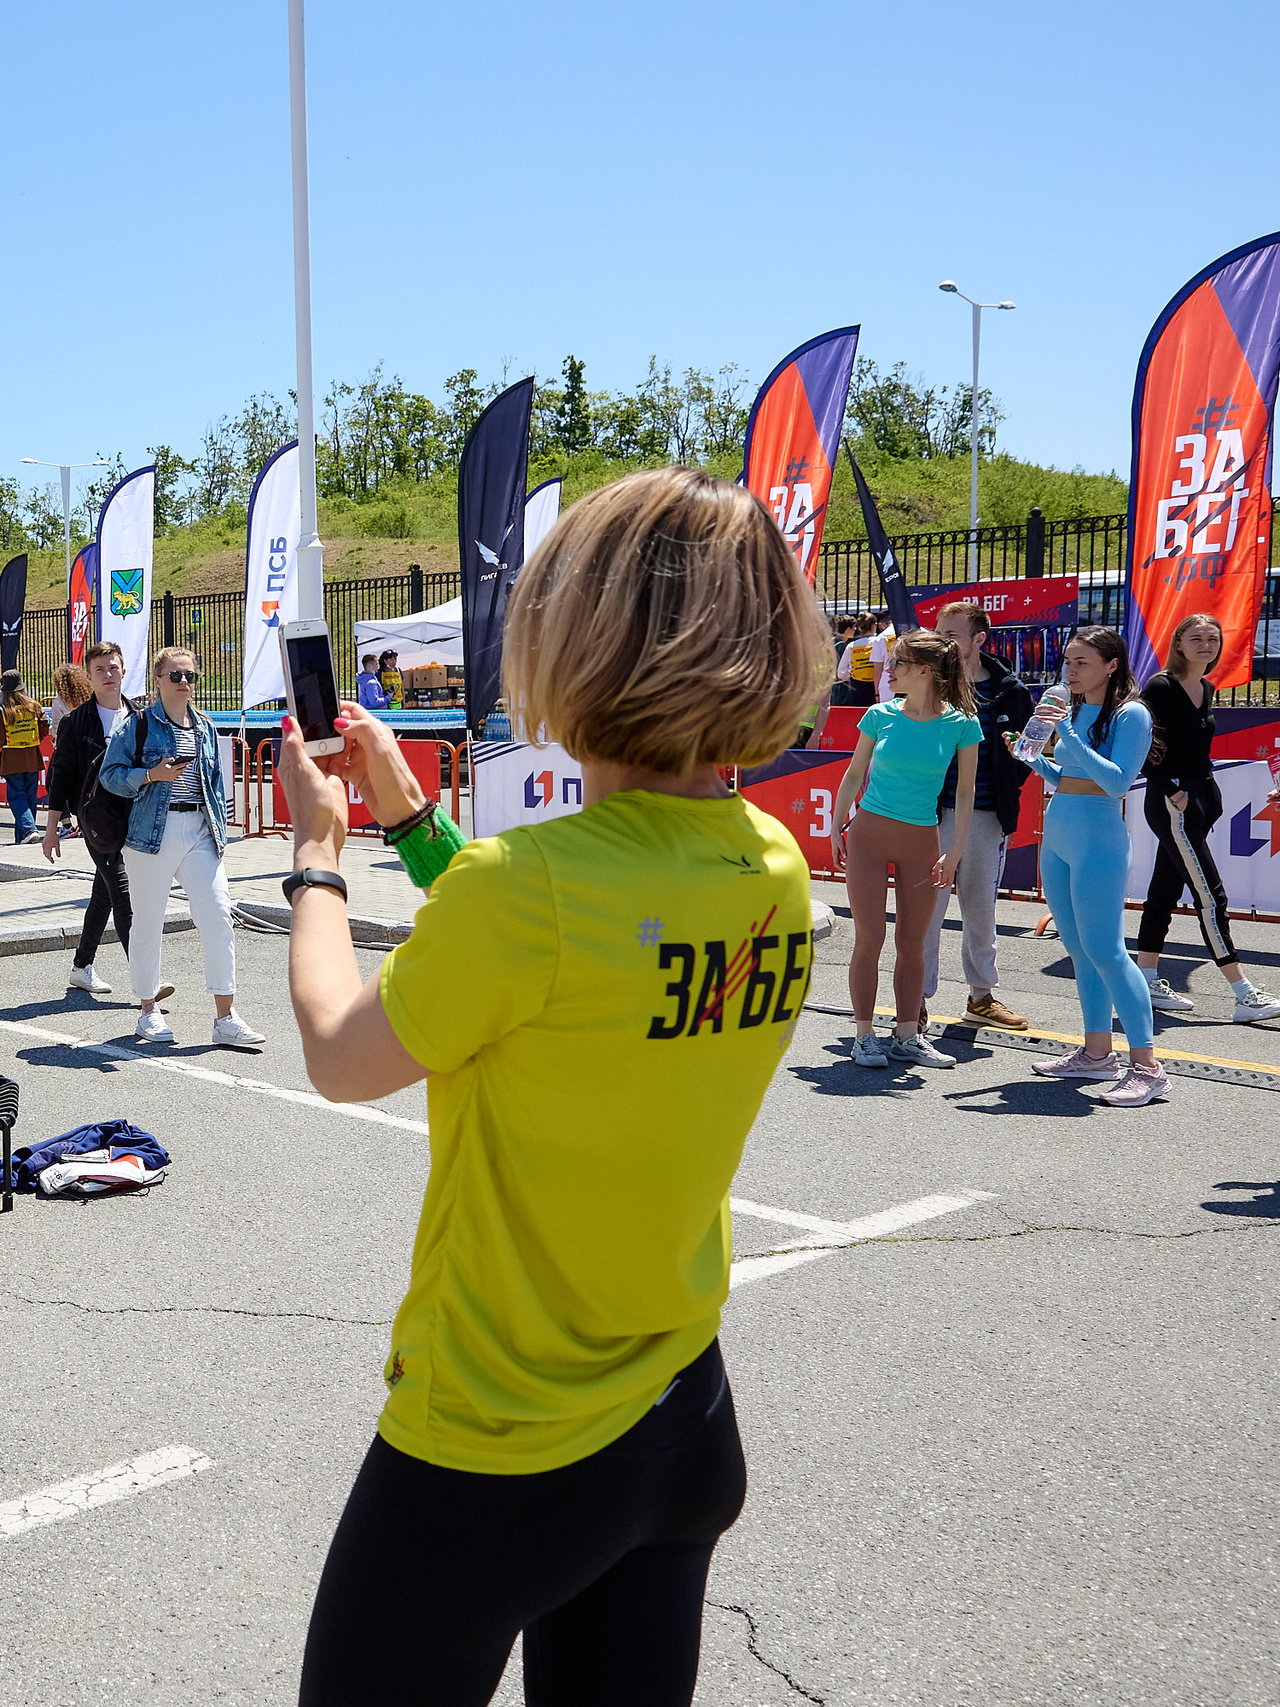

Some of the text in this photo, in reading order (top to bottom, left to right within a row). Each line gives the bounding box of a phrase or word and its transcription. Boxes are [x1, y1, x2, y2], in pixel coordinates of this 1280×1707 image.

[1171, 428, 1246, 497] ЗА
[769, 483, 815, 534] ЗА
[1155, 488, 1250, 559] БЕГ
[266, 536, 287, 592] ПСБ
[983, 595, 1008, 611] БЕГ
[738, 929, 815, 1030] БЕ
